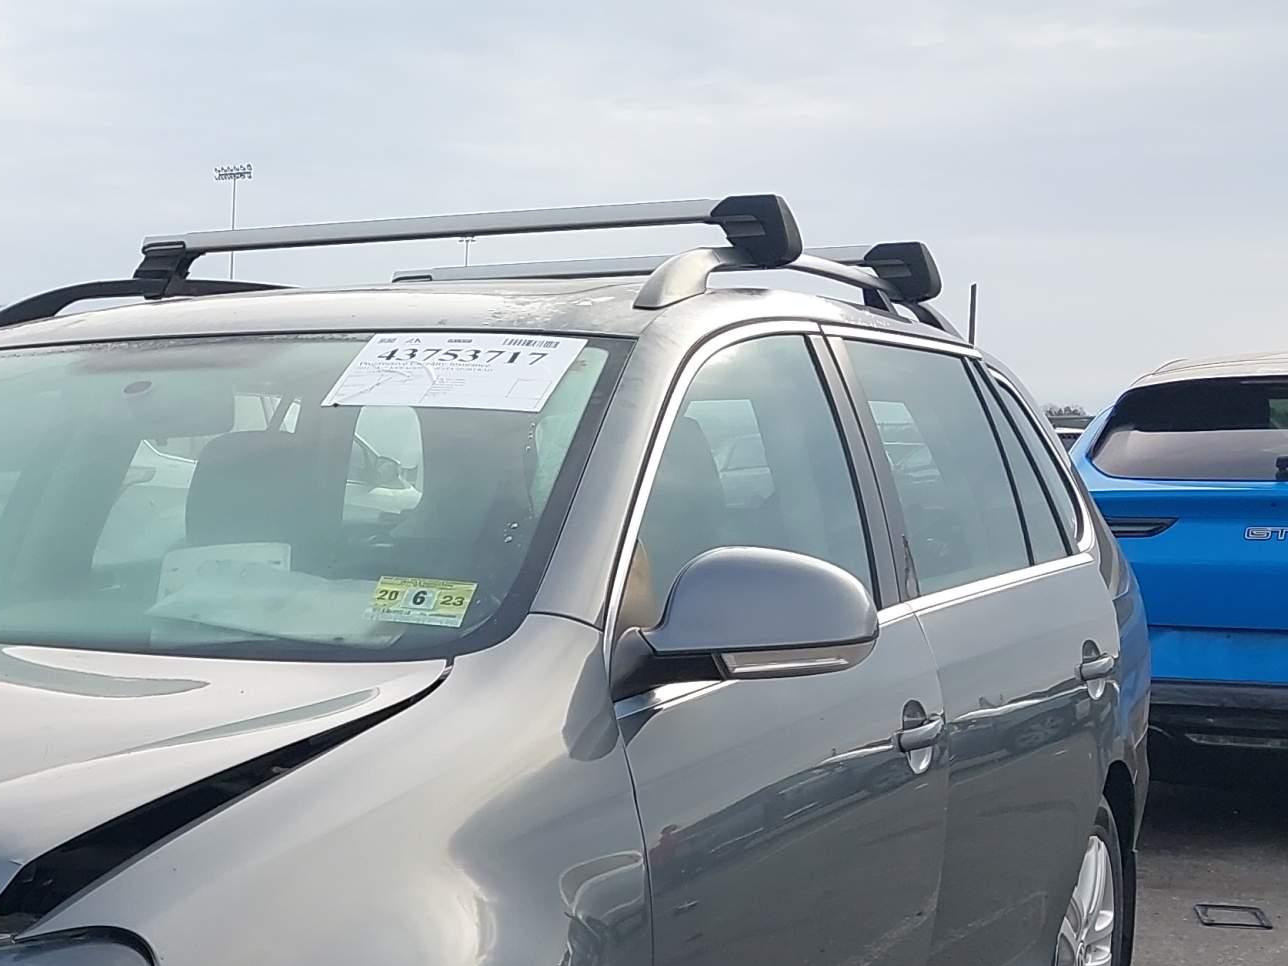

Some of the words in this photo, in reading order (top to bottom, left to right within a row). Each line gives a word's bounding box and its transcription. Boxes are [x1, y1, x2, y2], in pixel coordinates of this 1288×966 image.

[376, 348, 549, 366] 43753717
[376, 589, 400, 601] 20
[412, 590, 428, 606] 6
[440, 595, 465, 607] 23
